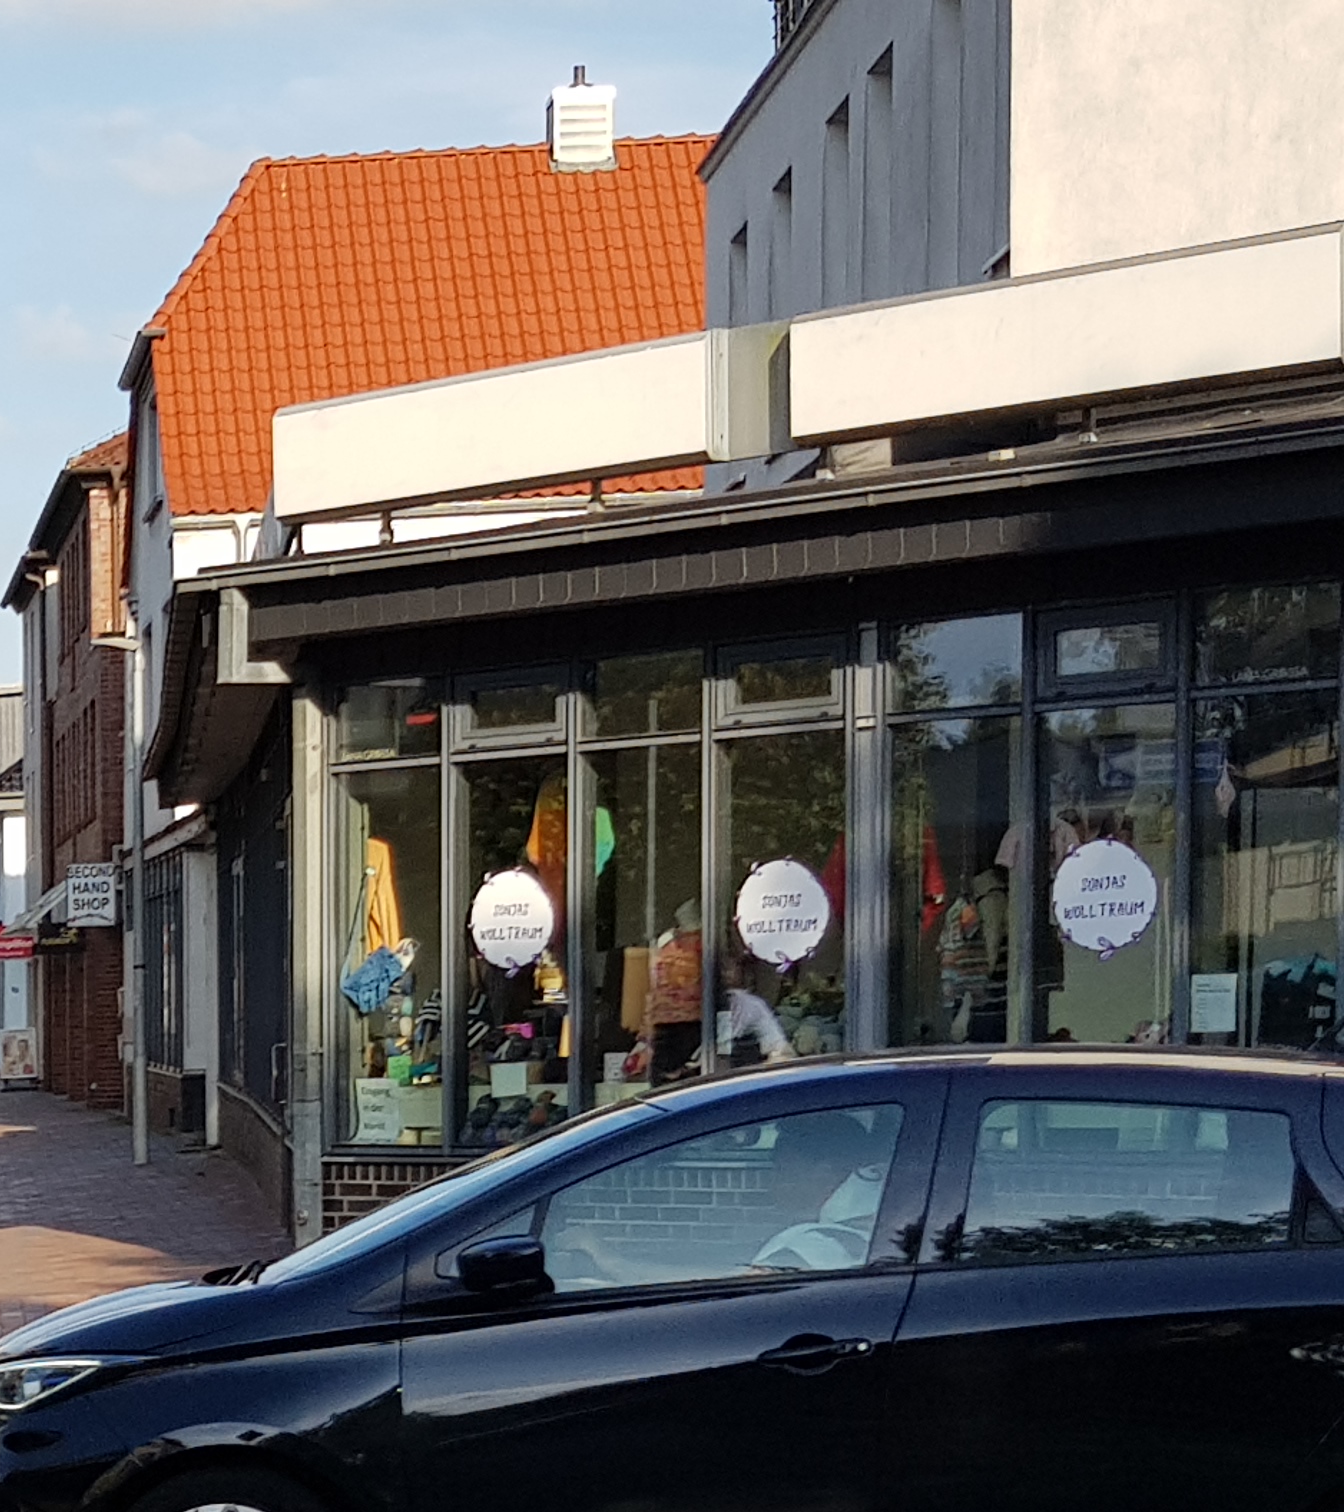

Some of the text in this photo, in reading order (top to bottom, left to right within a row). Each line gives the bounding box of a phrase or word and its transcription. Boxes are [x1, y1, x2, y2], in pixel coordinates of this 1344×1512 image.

[67, 864, 115, 879] SECOND
[72, 881, 110, 895] HAND
[1081, 874, 1127, 893] SONJAS
[72, 897, 110, 912] SHOP
[761, 893, 803, 909] SONJAS
[492, 903, 531, 918] SONJAS
